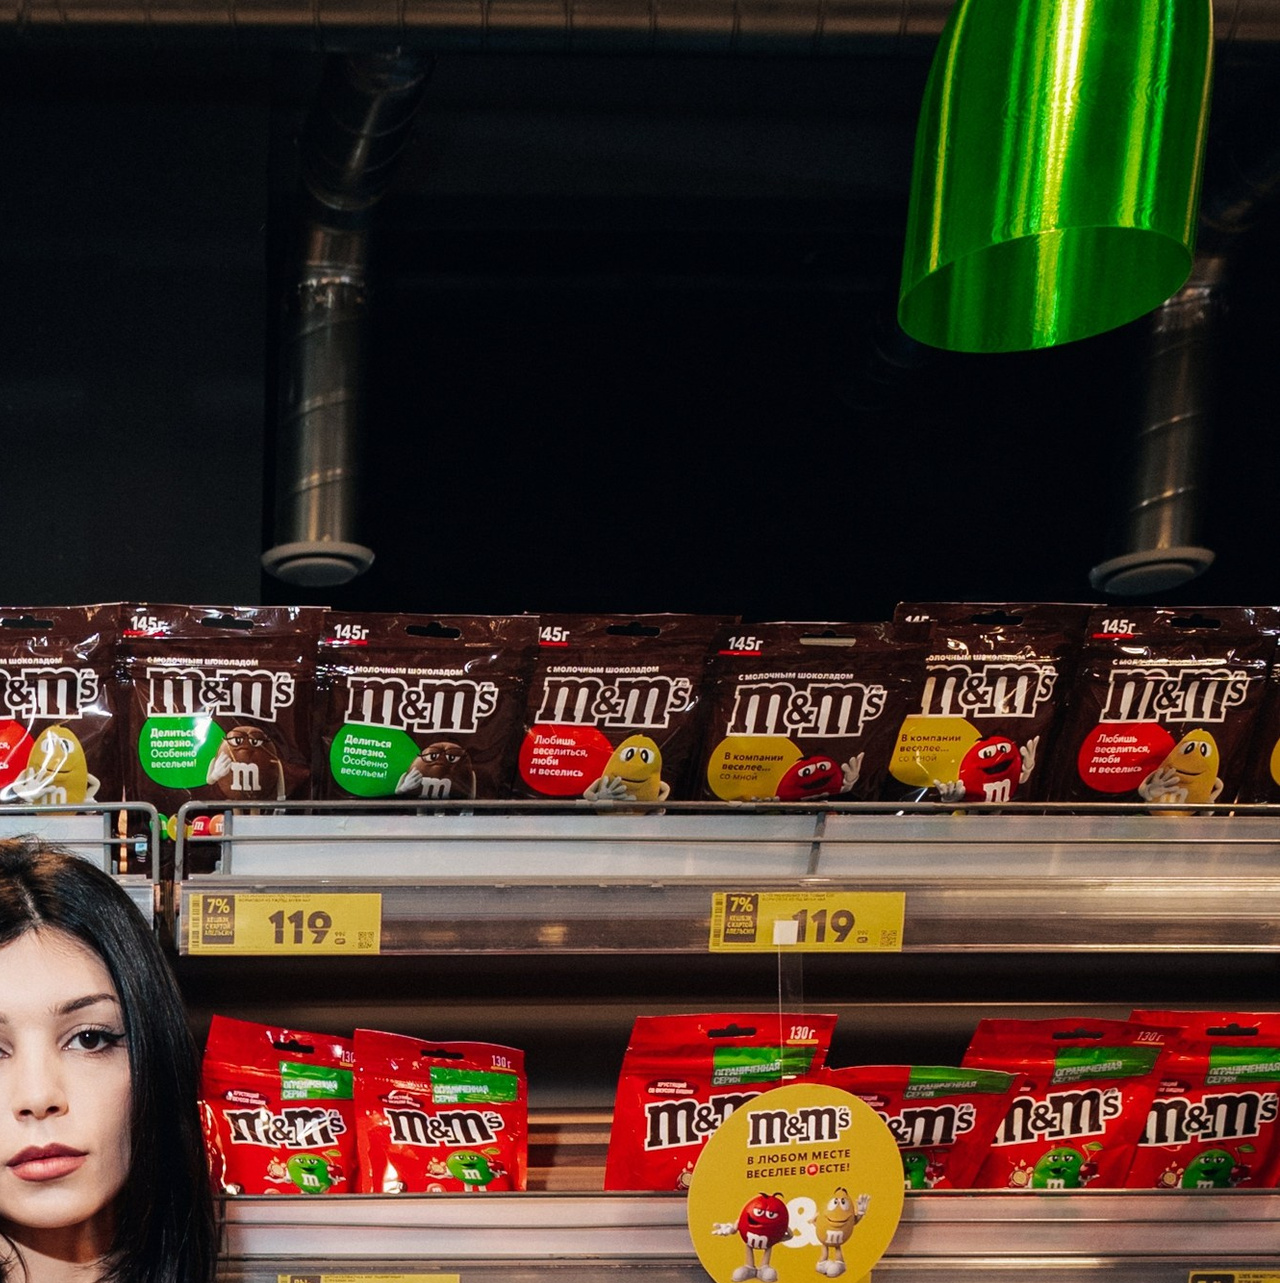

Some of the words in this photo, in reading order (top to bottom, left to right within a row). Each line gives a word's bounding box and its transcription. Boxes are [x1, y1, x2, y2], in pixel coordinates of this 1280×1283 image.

[334, 625, 369, 640] 145г
[1101, 619, 1136, 634] 145г
[728, 637, 763, 651] 145г
[355, 665, 405, 674] молочным
[407, 667, 463, 676] шоколадом
[553, 665, 603, 674] молочным
[605, 665, 659, 674] шоколадом
[797, 672, 854, 680] шоколадом
[147, 667, 295, 722] m&m's
[1099, 669, 1249, 723] m&m's
[344, 676, 499, 733] m&m's
[534, 676, 693, 729] m&m's
[726, 683, 887, 737] m&m's
[345, 735, 391, 748] Делиться
[534, 734, 576, 746] Любишь
[343, 746, 387, 758] полезно.
[533, 748, 588, 758] веселиться,
[724, 752, 732, 761] В
[734, 753, 784, 763] компании
[342, 756, 389, 769] Особенно
[531, 757, 559, 767] люби
[340, 767, 387, 779] весельем!
[538, 767, 584, 777] веселись
[731, 772, 758, 781] мной
[207, 899, 230, 914] 7%
[730, 897, 753, 912] 7%
[268, 910, 333, 944] 119
[792, 909, 855, 942] 119
[223, 1107, 346, 1148] m&m's
[385, 1107, 504, 1146] m&m's
[747, 1107, 851, 1148] m&m's
[747, 1156, 754, 1165] В
[758, 1152, 808, 1164] ЛЮБОМ
[811, 1149, 851, 1160] МЕСТЕ
[746, 1168, 797, 1178] ВЕСЕЛЕЕ
